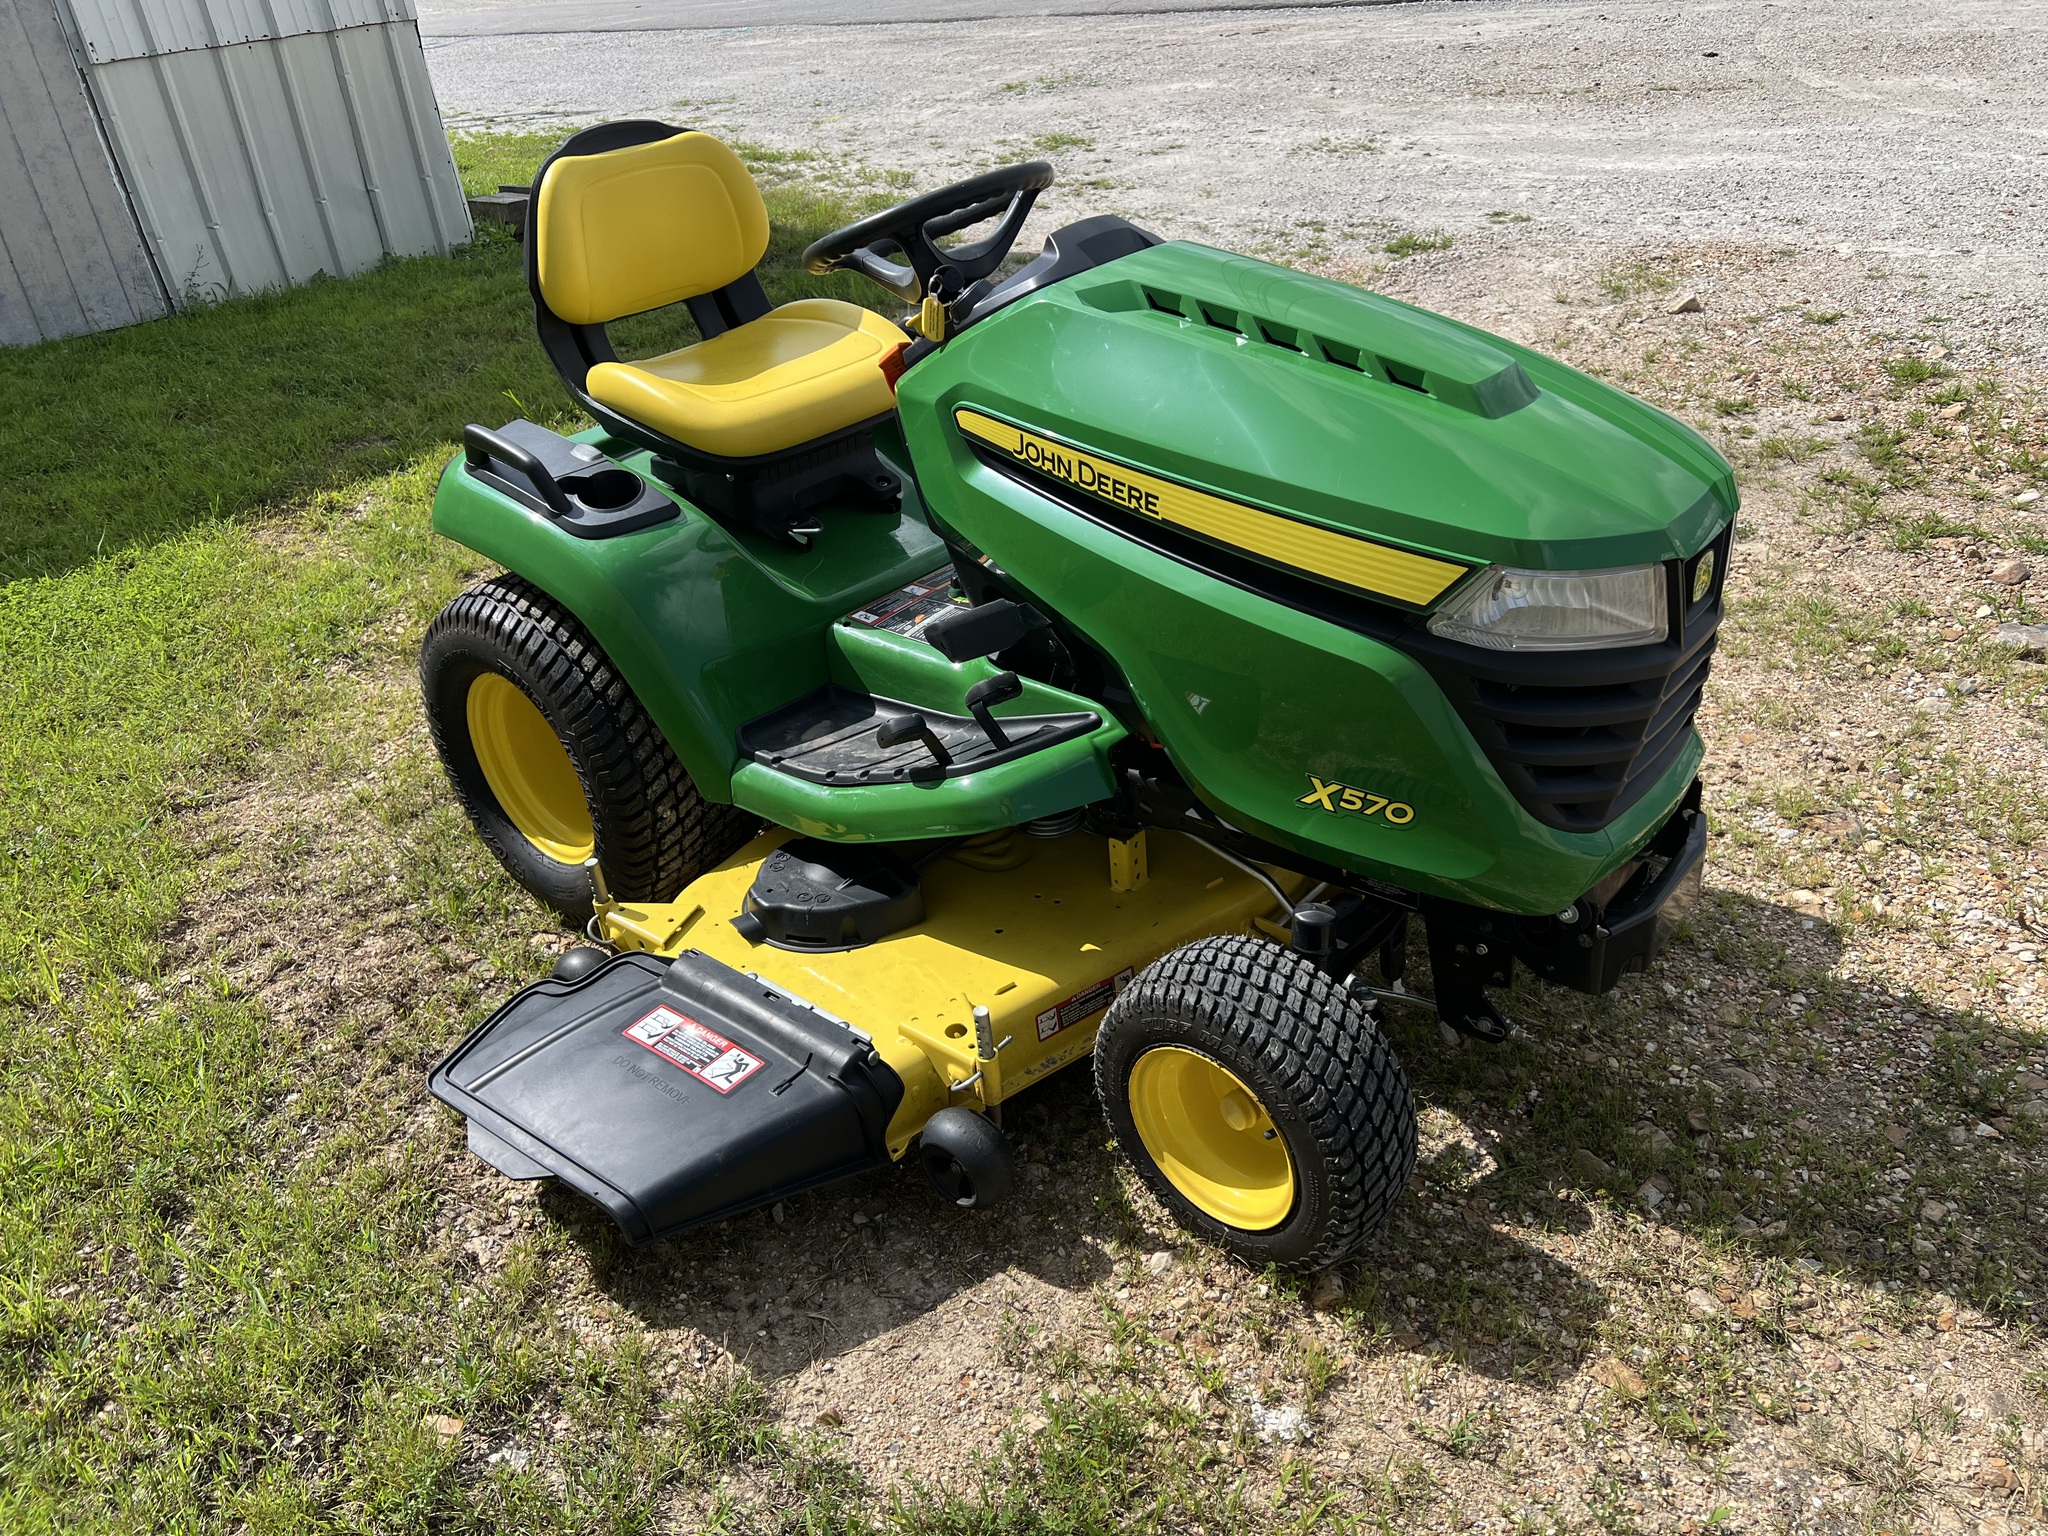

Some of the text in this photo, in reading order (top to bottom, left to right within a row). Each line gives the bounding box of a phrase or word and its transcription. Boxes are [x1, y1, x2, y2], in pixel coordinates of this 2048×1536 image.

[1012, 433, 1161, 518] JOHN DEERE
[1299, 775, 1416, 825] X570
[697, 1026, 729, 1048] DANGER
[1140, 1017, 1192, 1035] TURF
[613, 1055, 694, 1107] DO NOT REMOVE
